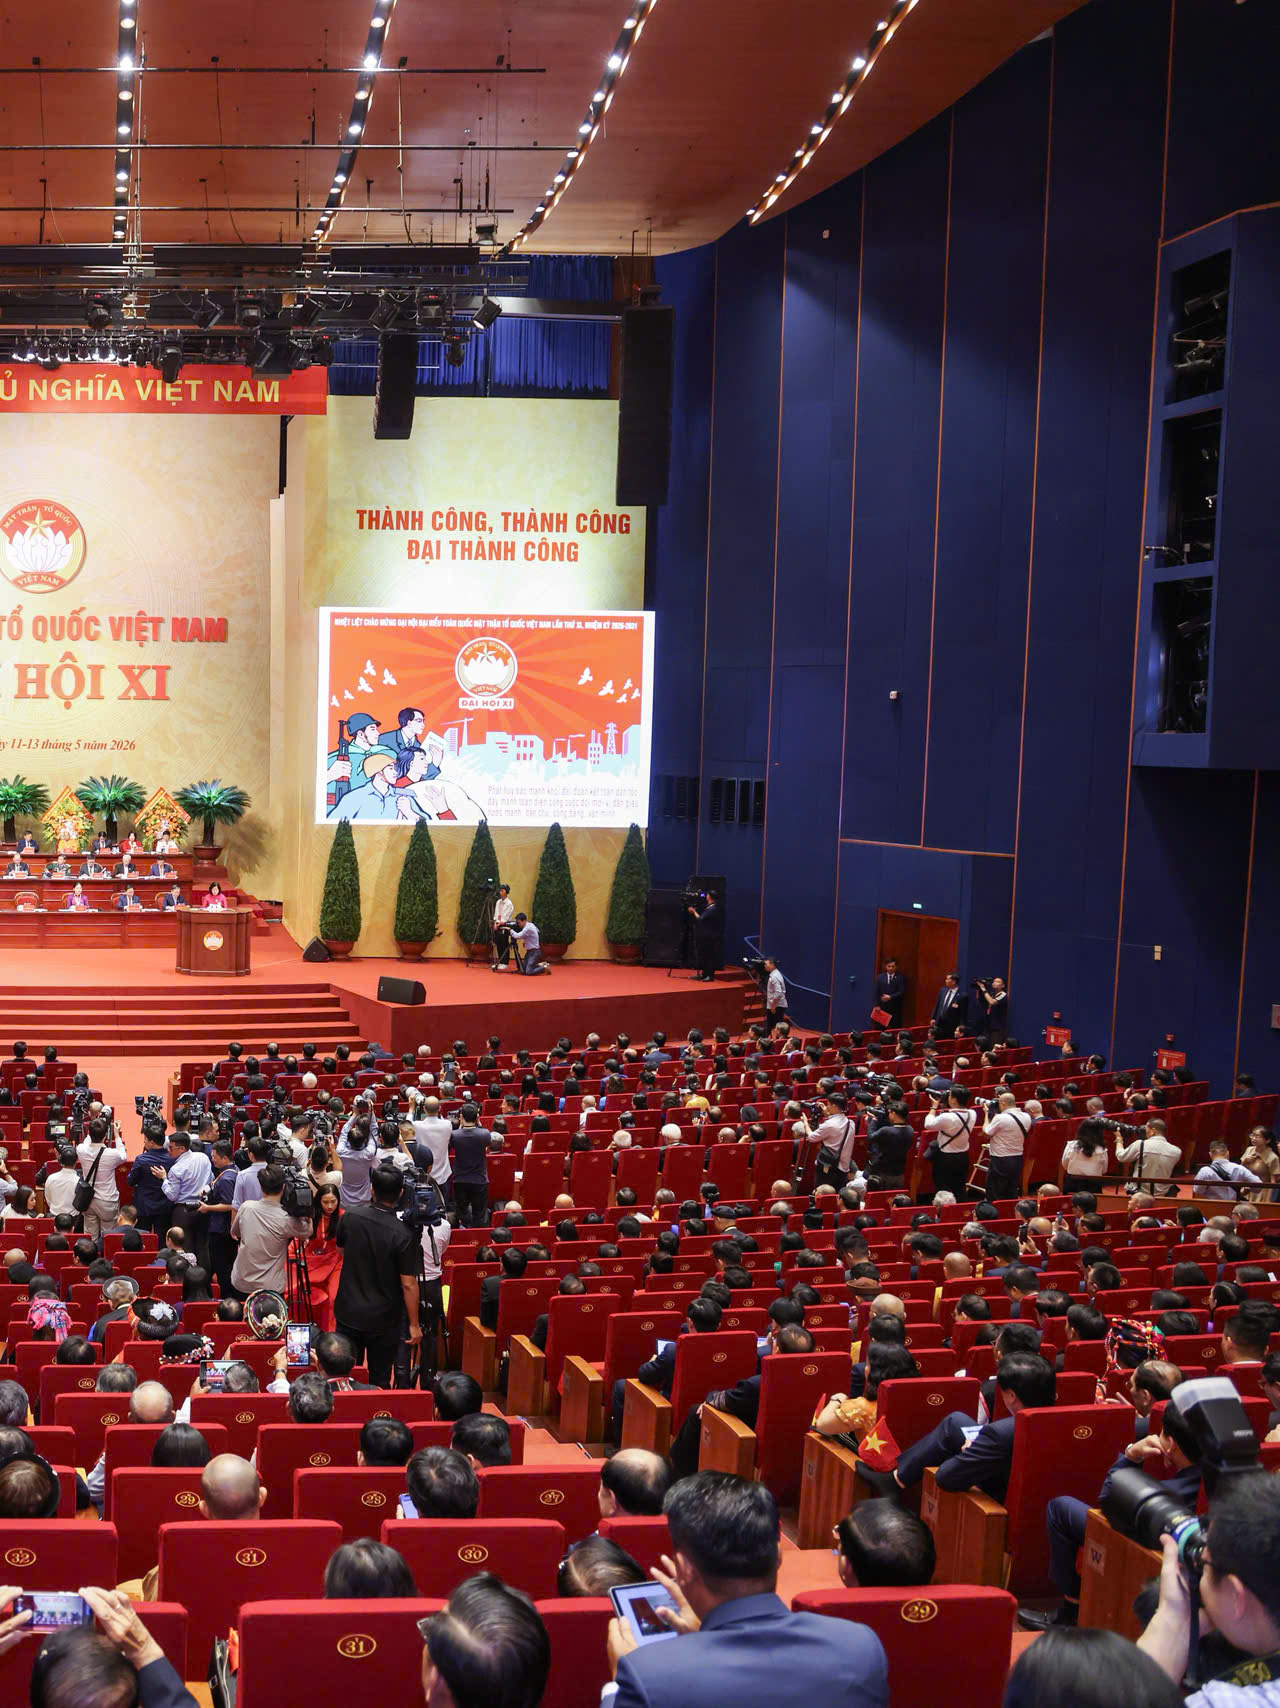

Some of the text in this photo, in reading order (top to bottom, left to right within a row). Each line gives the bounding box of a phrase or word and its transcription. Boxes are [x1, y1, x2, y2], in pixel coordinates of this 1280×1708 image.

[29, 374, 125, 401] NGHĨA
[214, 380, 280, 402] NAM
[356, 505, 631, 534] THÀNH CÔNG, THÀNH CÔNG
[407, 536, 579, 564] ĐẠI THÀNH CÔNG
[32, 606, 100, 643] QUỐC
[109, 609, 164, 647] VIỆT
[171, 617, 228, 643] NAM
[14, 651, 105, 710] HỘI
[118, 664, 170, 700] XI
[11, 738, 39, 749] 11-13
[41, 739, 71, 752] tháng
[74, 739, 82, 750] 5
[83, 740, 107, 750] năm
[110, 740, 136, 750] 2026
[11, 1552, 30, 1564] 32
[242, 1552, 260, 1563] 31
[464, 1548, 482, 1560] 30
[1090, 1548, 1102, 1564] W
[908, 1602, 931, 1618] 29
[345, 1639, 369, 1654] 31
